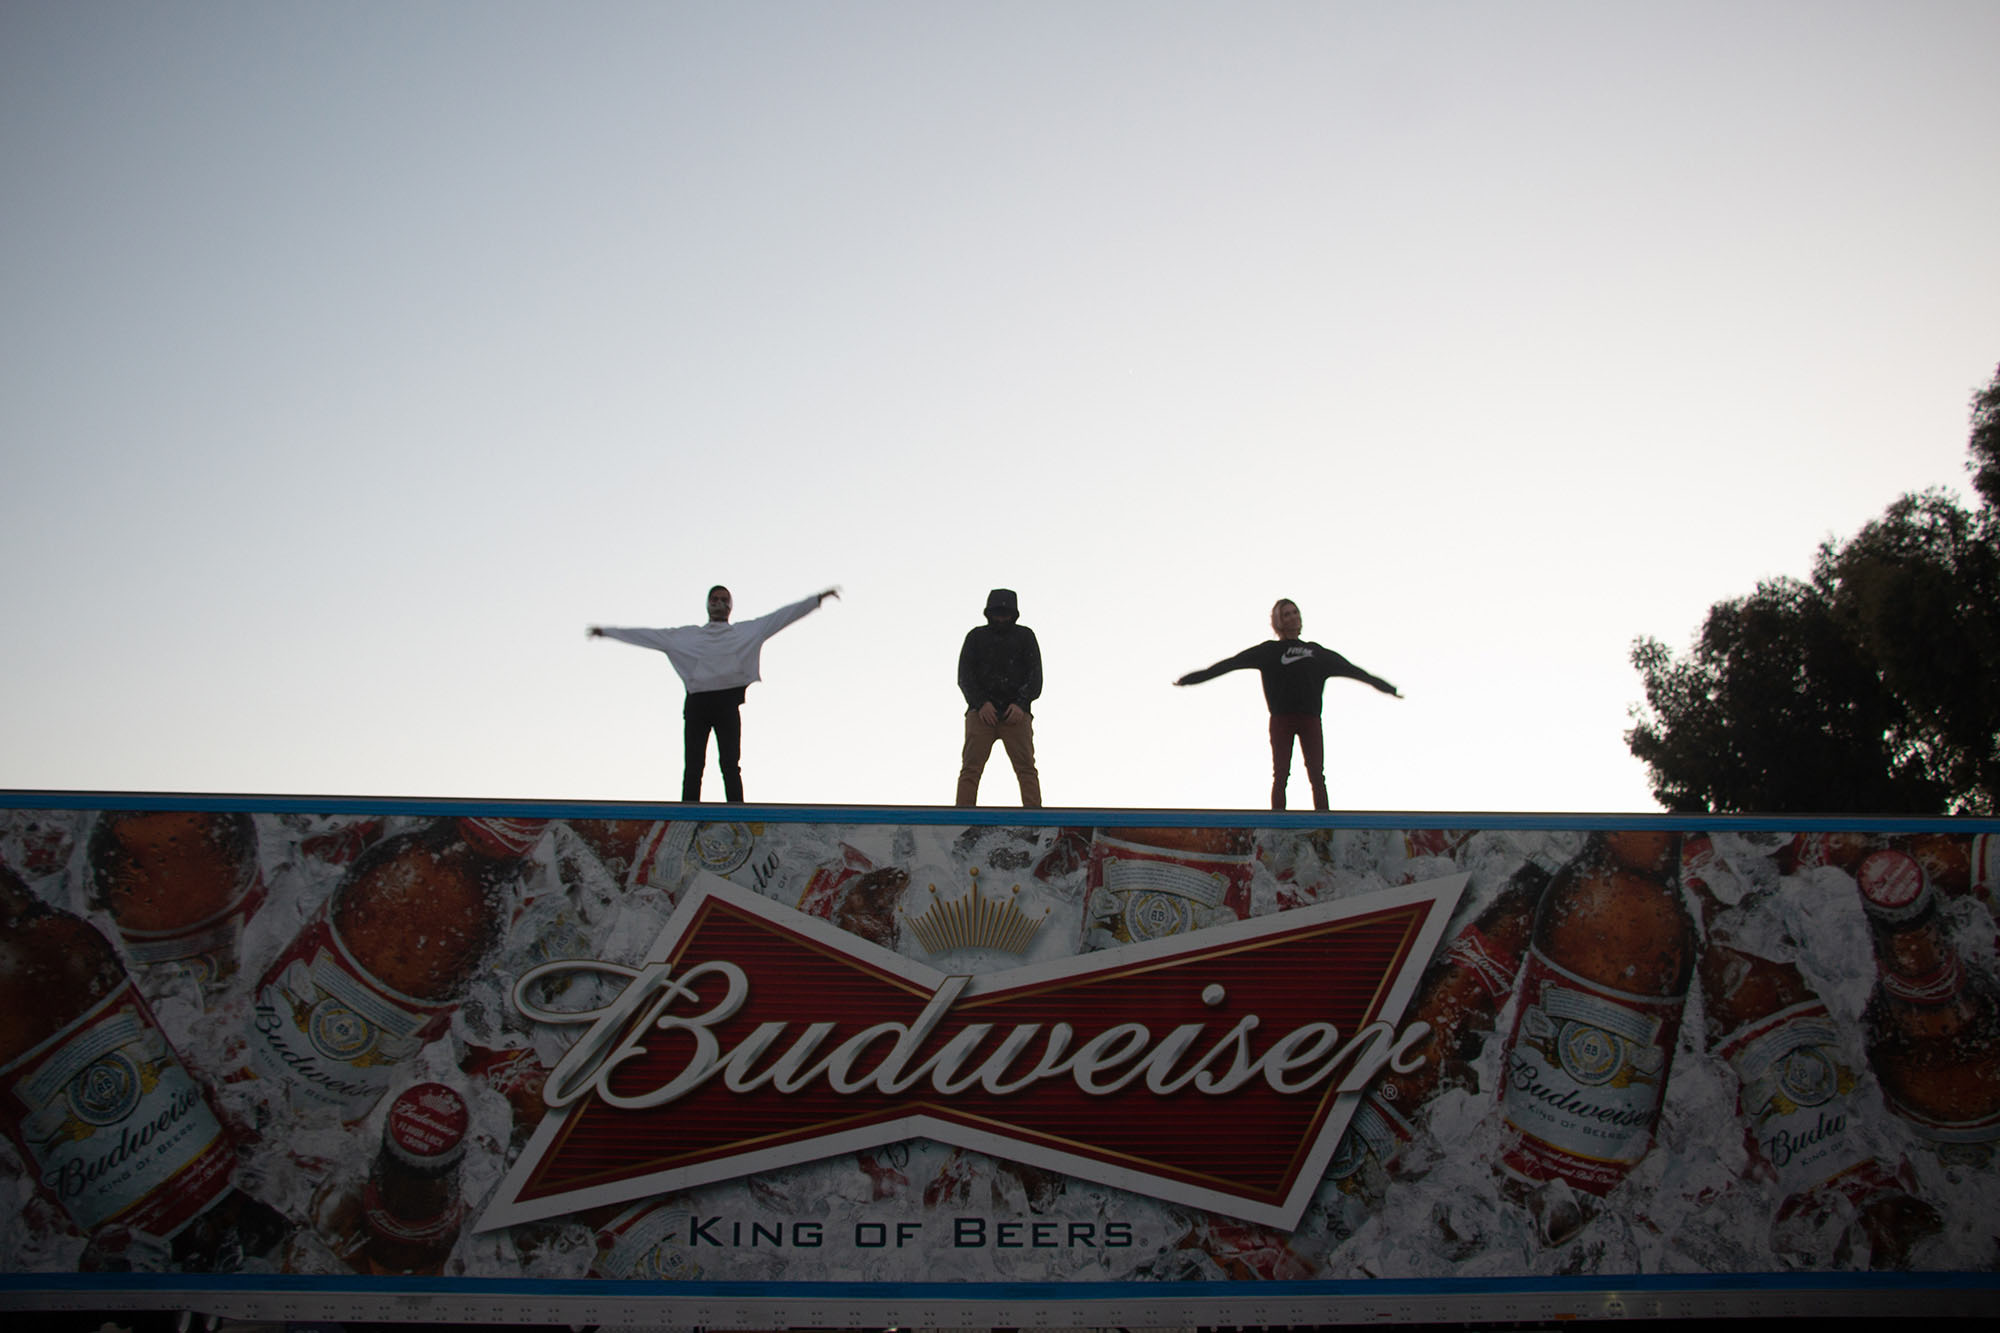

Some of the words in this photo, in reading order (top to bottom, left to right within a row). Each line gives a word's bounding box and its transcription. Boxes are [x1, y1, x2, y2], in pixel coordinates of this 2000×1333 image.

[512, 959, 1432, 1110] Budweiser
[689, 1215, 823, 1248] KING
[855, 1222, 922, 1248] OF
[953, 1218, 1133, 1248] BEERS
